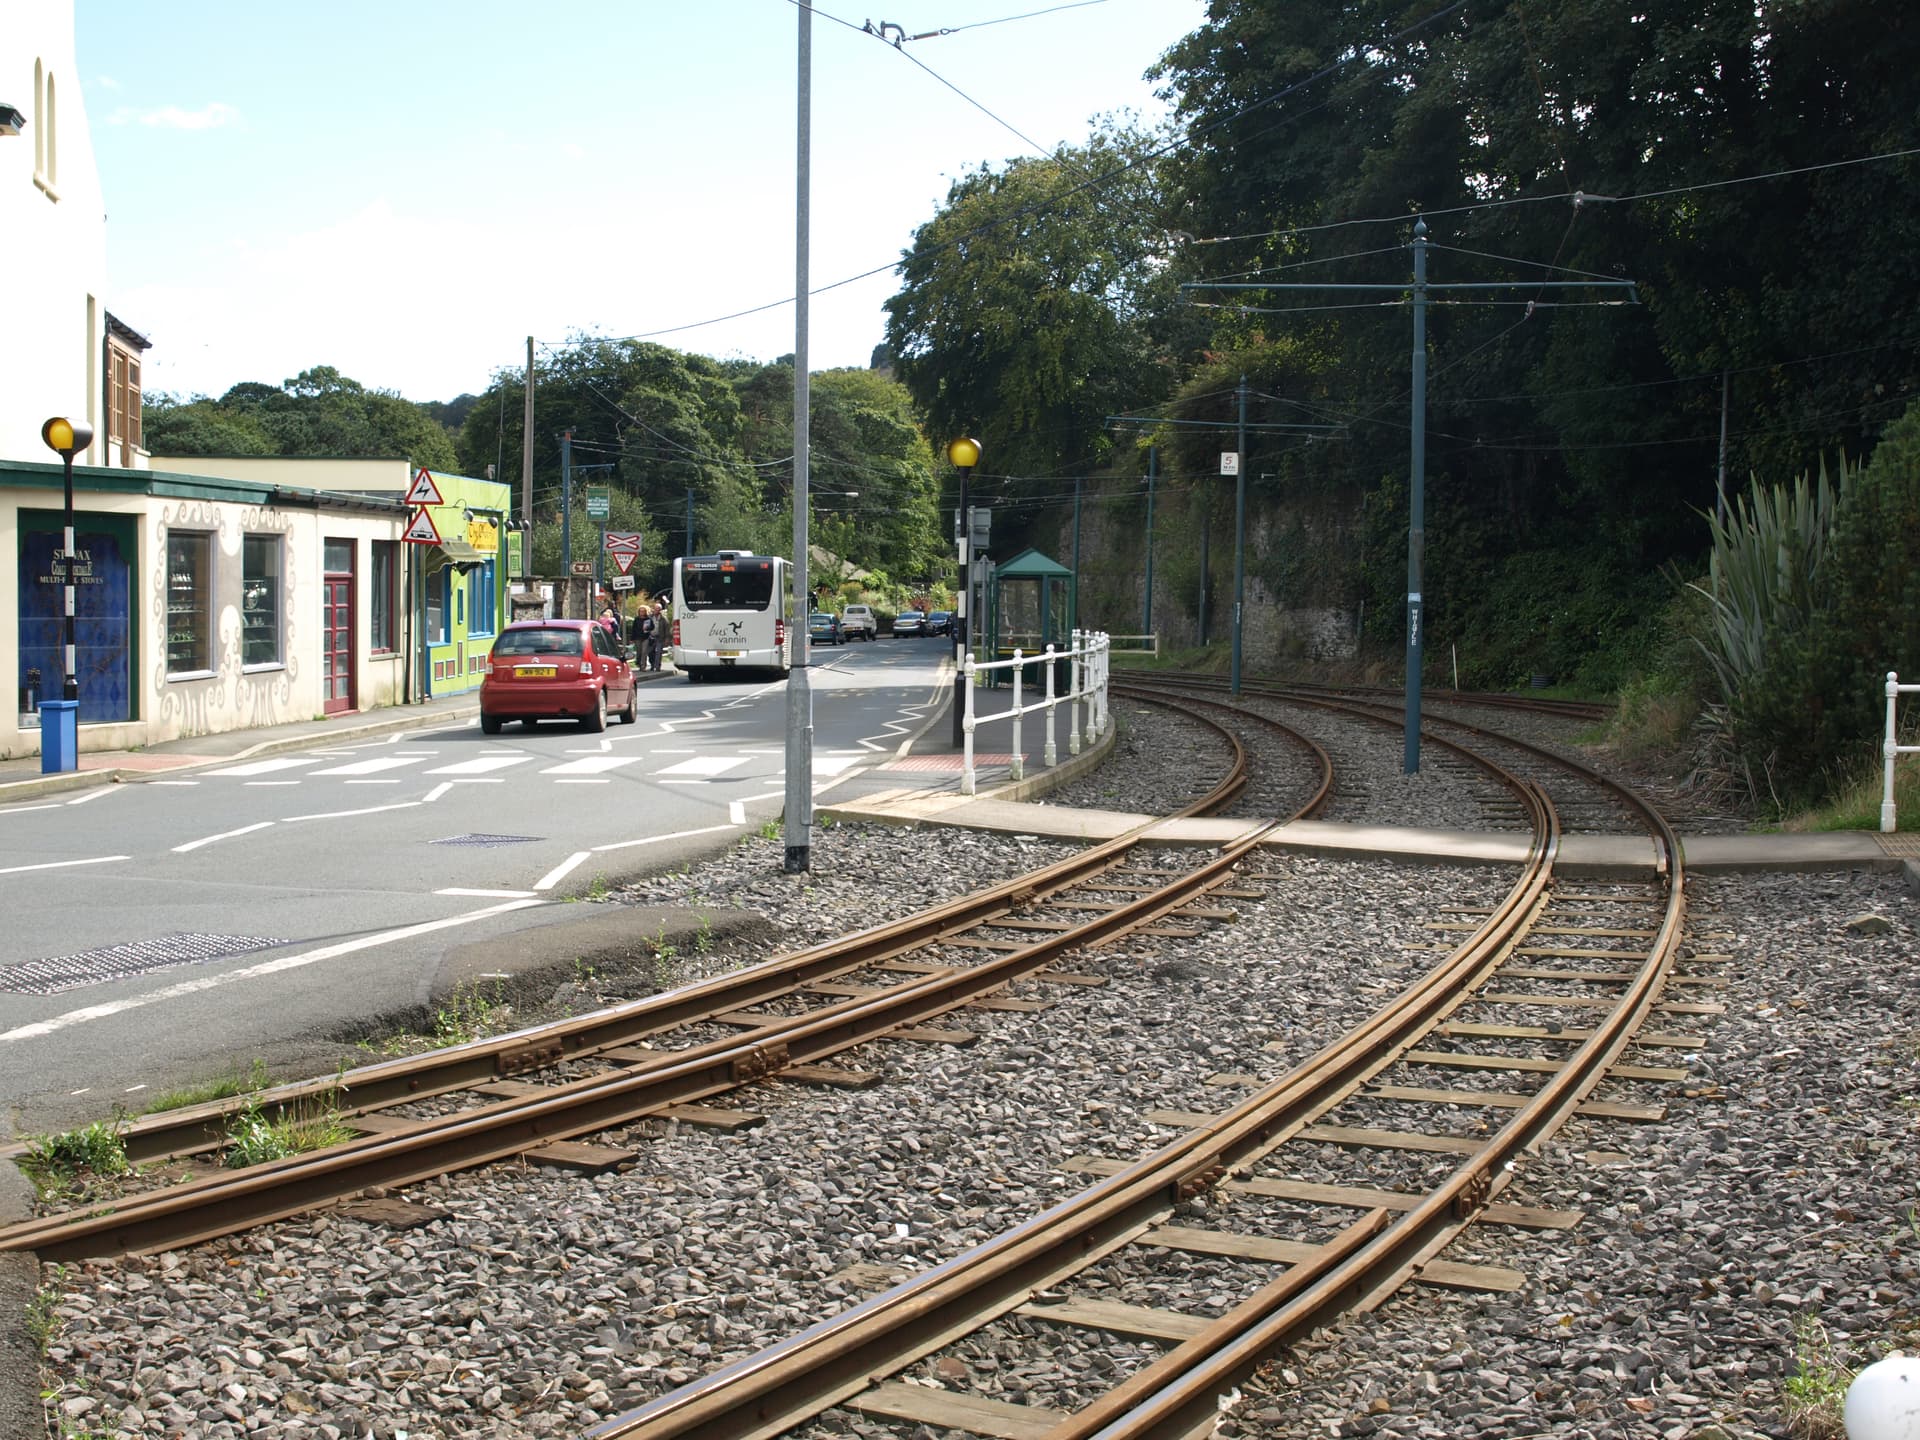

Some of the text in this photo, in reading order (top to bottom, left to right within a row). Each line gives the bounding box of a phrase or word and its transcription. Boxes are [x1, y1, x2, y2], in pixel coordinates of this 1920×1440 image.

[53, 549, 91, 560] STVAX
[709, 622, 728, 636] bus
[718, 636, 747, 645] vannin
